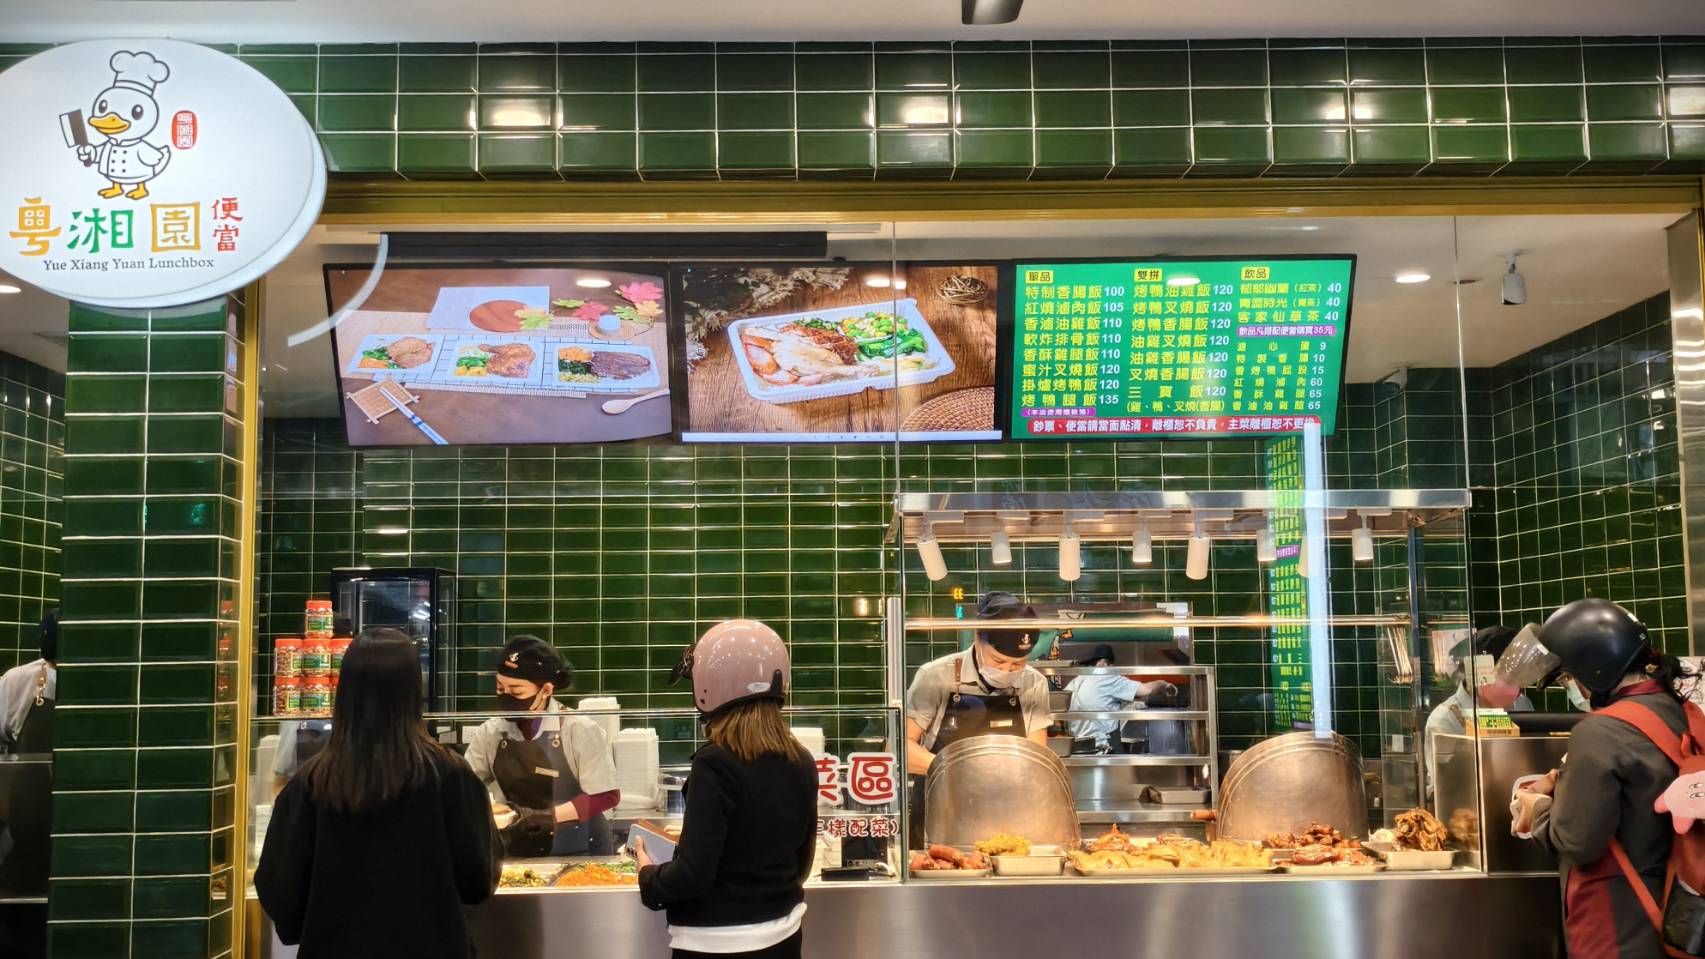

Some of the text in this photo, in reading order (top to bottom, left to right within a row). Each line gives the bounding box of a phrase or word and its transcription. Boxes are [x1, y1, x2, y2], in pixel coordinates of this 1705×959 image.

[9, 196, 202, 256] 粵湘園
[211, 197, 244, 252] 便當
[43, 256, 215, 272] Yue Xiang Yuan Lunchbox
[1027, 271, 1052, 282] 單品
[1137, 270, 1159, 281] 雙拼
[1244, 268, 1267, 279] 飲品
[1104, 286, 1125, 297] 100
[1213, 284, 1234, 295] 120
[1327, 283, 1341, 293] 40
[1103, 302, 1124, 312] 105
[1326, 297, 1340, 307] 40
[1133, 301, 1232, 315] 烤鴨叉燒飯 120
[1324, 311, 1339, 321] 40
[1102, 318, 1122, 328] 110
[1132, 317, 1231, 331] 烤鴨香腸飯 120
[1101, 334, 1121, 344] 110
[1131, 334, 1230, 348] 油雞叉燒飯 120
[1319, 342, 1326, 350] 9
[1100, 349, 1120, 359] 110
[1130, 351, 1228, 365] 油雞香腸飯 120
[1313, 353, 1325, 363] 10
[1100, 364, 1120, 374] 120
[1312, 365, 1324, 375] 15
[1129, 368, 1227, 381] 叉燒香腸飯 120
[1099, 379, 1119, 389] 120
[1310, 377, 1323, 387] 60
[1205, 386, 1226, 396] 120
[1309, 389, 1322, 398] 65
[1098, 394, 1119, 404] 135
[1308, 401, 1321, 410] 65
